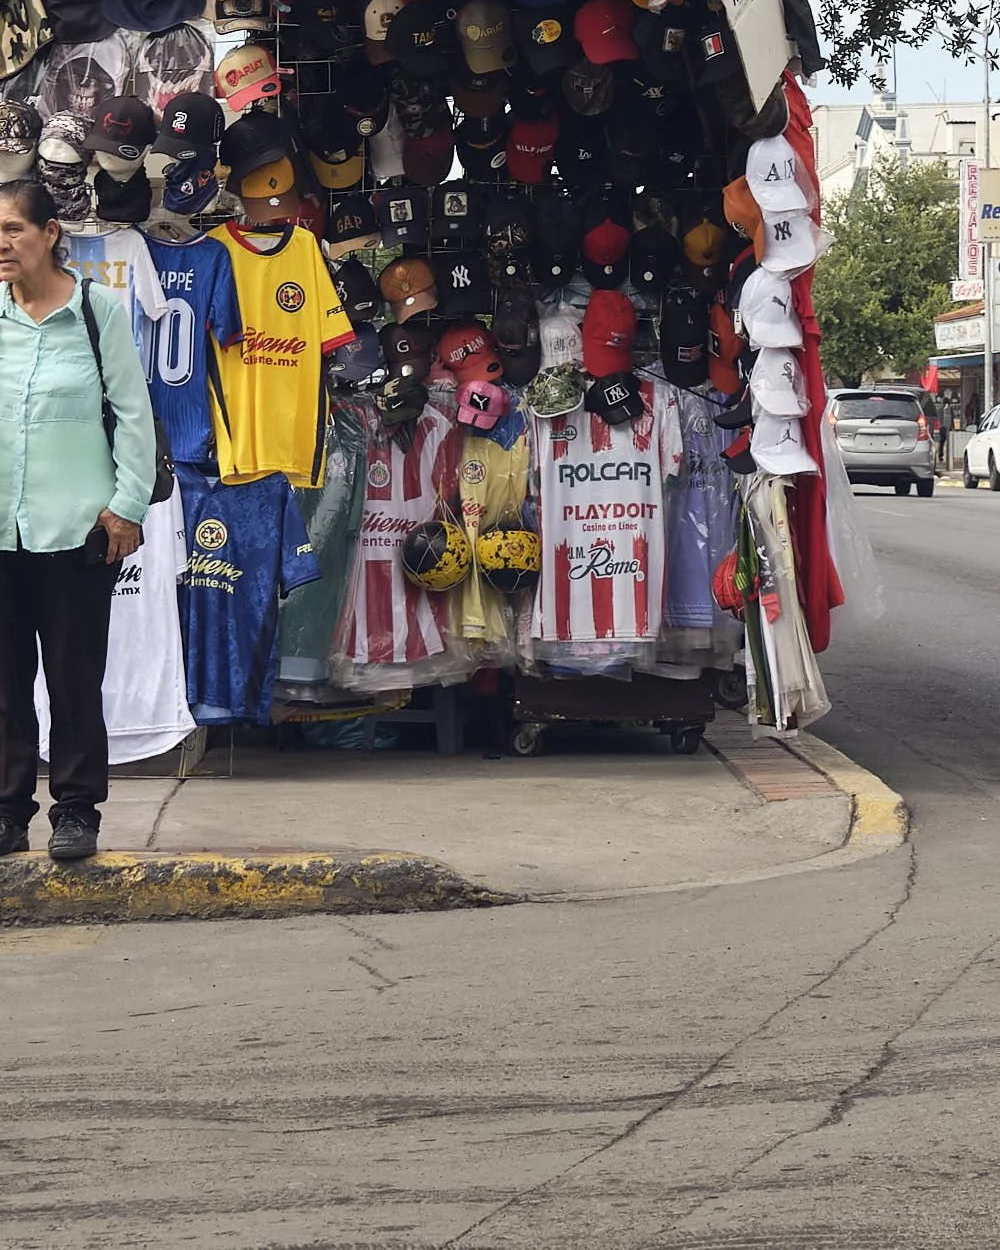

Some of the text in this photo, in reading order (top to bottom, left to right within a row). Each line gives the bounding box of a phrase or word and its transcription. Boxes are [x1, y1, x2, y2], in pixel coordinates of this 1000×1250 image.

[337, 215, 363, 234] GAP
[160, 268, 196, 292] APPÉ
[559, 461, 652, 488] ROLCAR
[563, 502, 658, 521] PLAYDOIT
[582, 522, 607, 532] Casino
